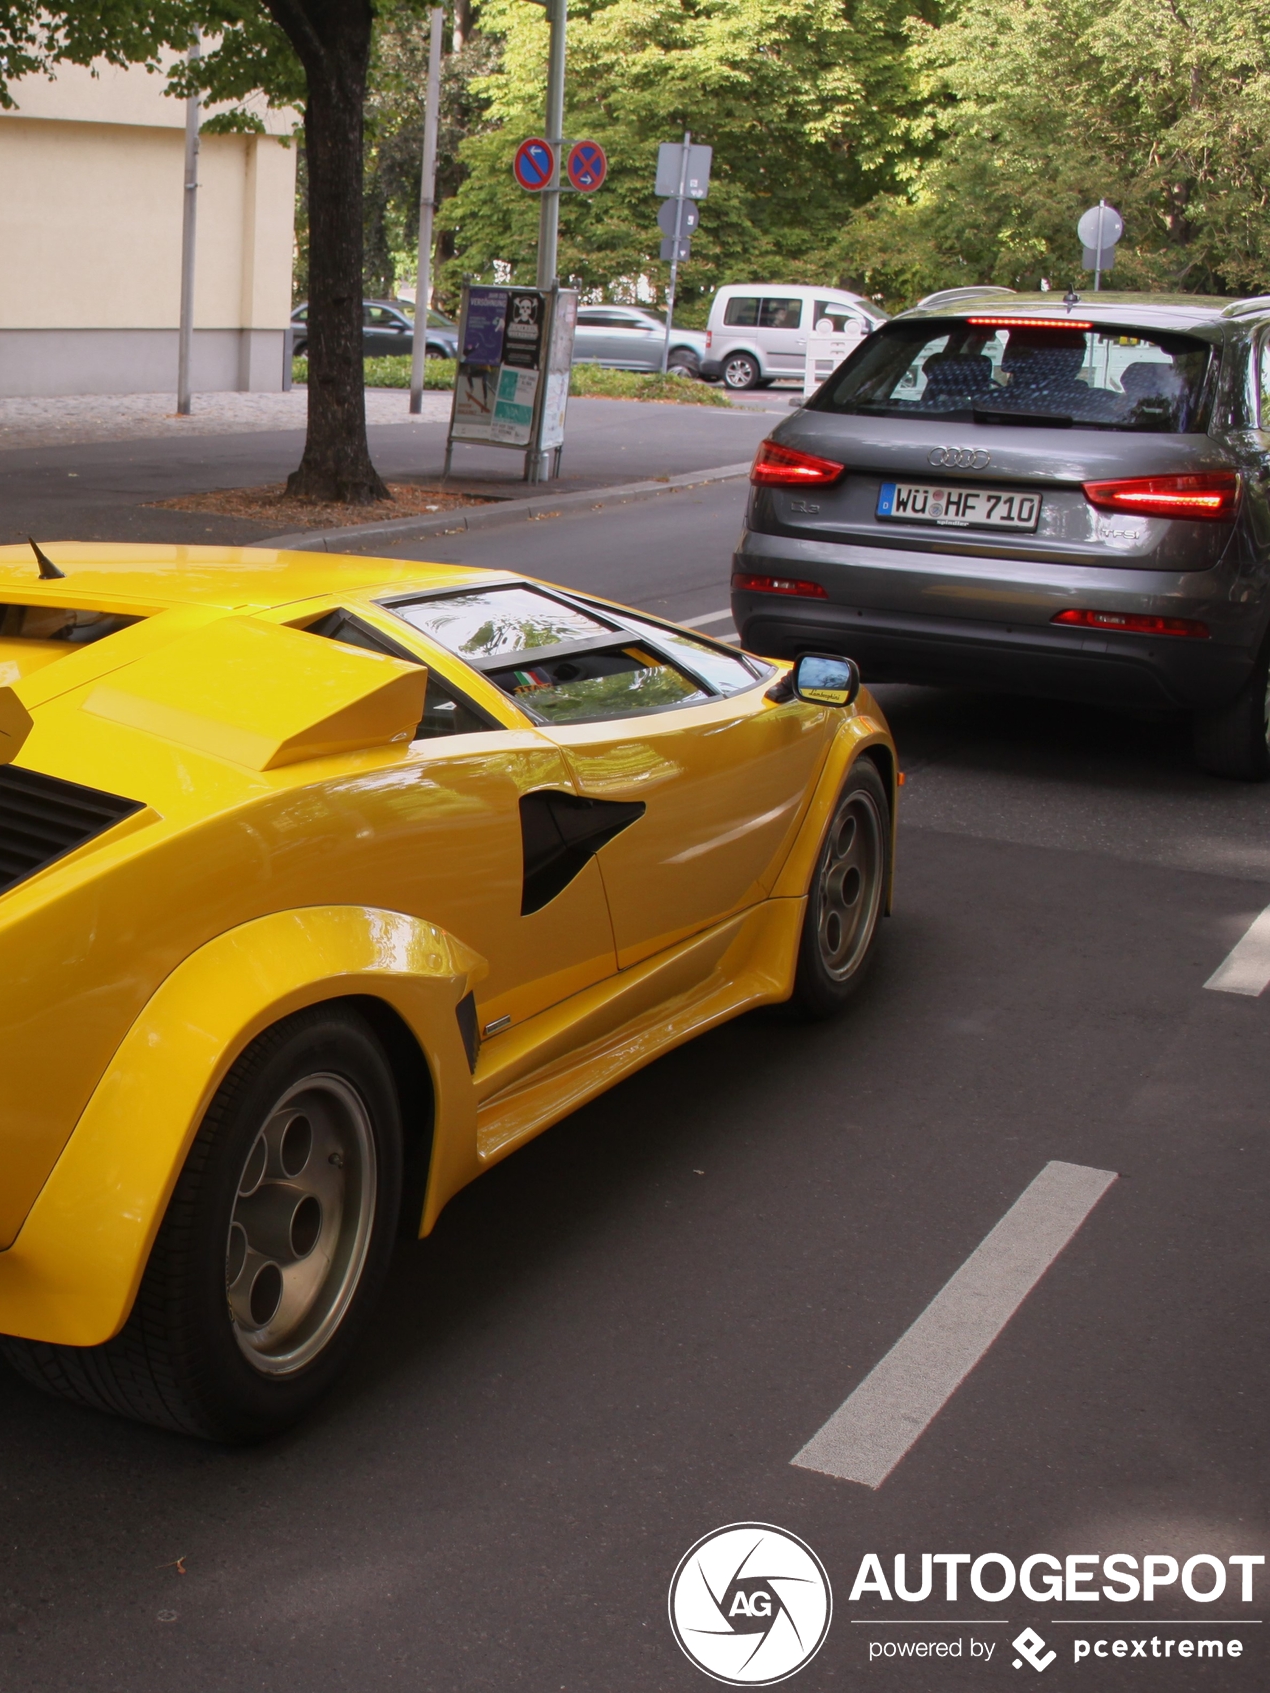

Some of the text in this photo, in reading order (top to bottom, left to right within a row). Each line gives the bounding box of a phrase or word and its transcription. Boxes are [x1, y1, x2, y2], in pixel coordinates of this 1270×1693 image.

[790, 500, 820, 515] Q3
[883, 488, 1035, 523] D WÜ HF 710
[1102, 528, 1140, 540] TFSI
